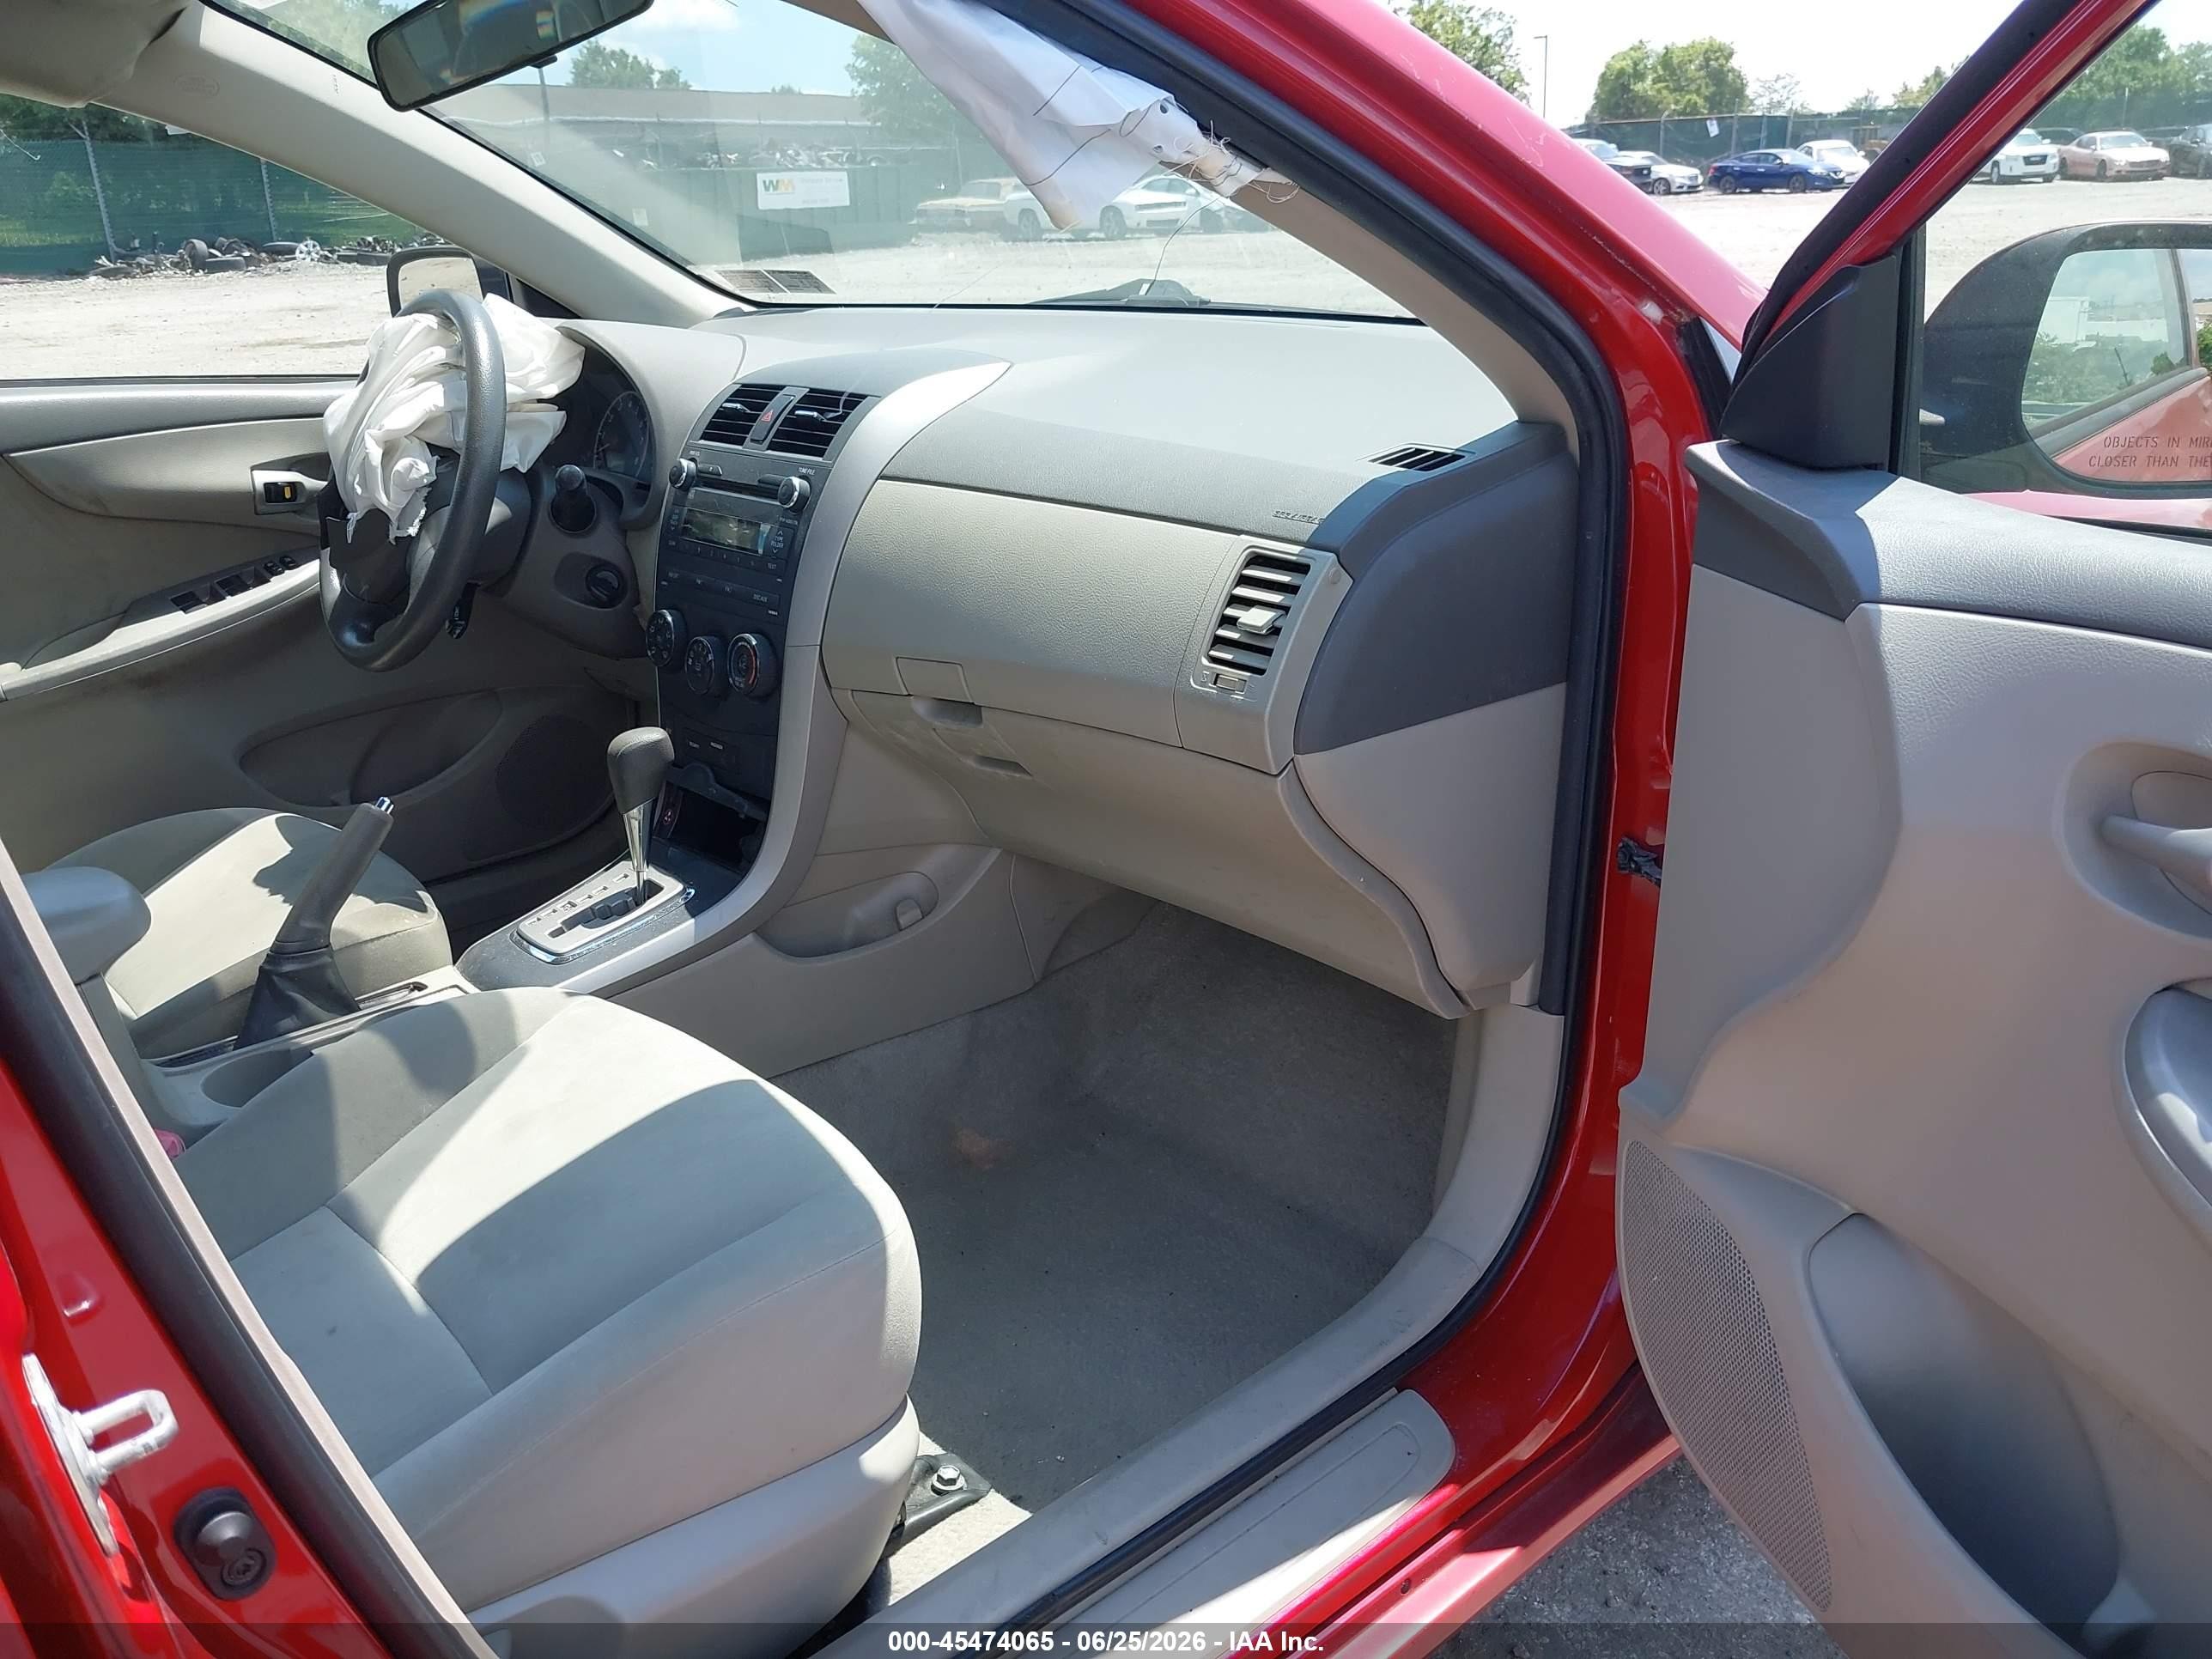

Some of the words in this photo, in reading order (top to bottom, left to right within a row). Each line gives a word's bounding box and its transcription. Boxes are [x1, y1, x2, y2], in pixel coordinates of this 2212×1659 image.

[762, 178, 795, 192] WM
[2104, 436, 2159, 447] OBJECTS
[2167, 436, 2180, 447] IN
[2189, 436, 2212, 447] MIR
[2088, 455, 2137, 467] CLOSER
[2147, 455, 2179, 467] THAN
